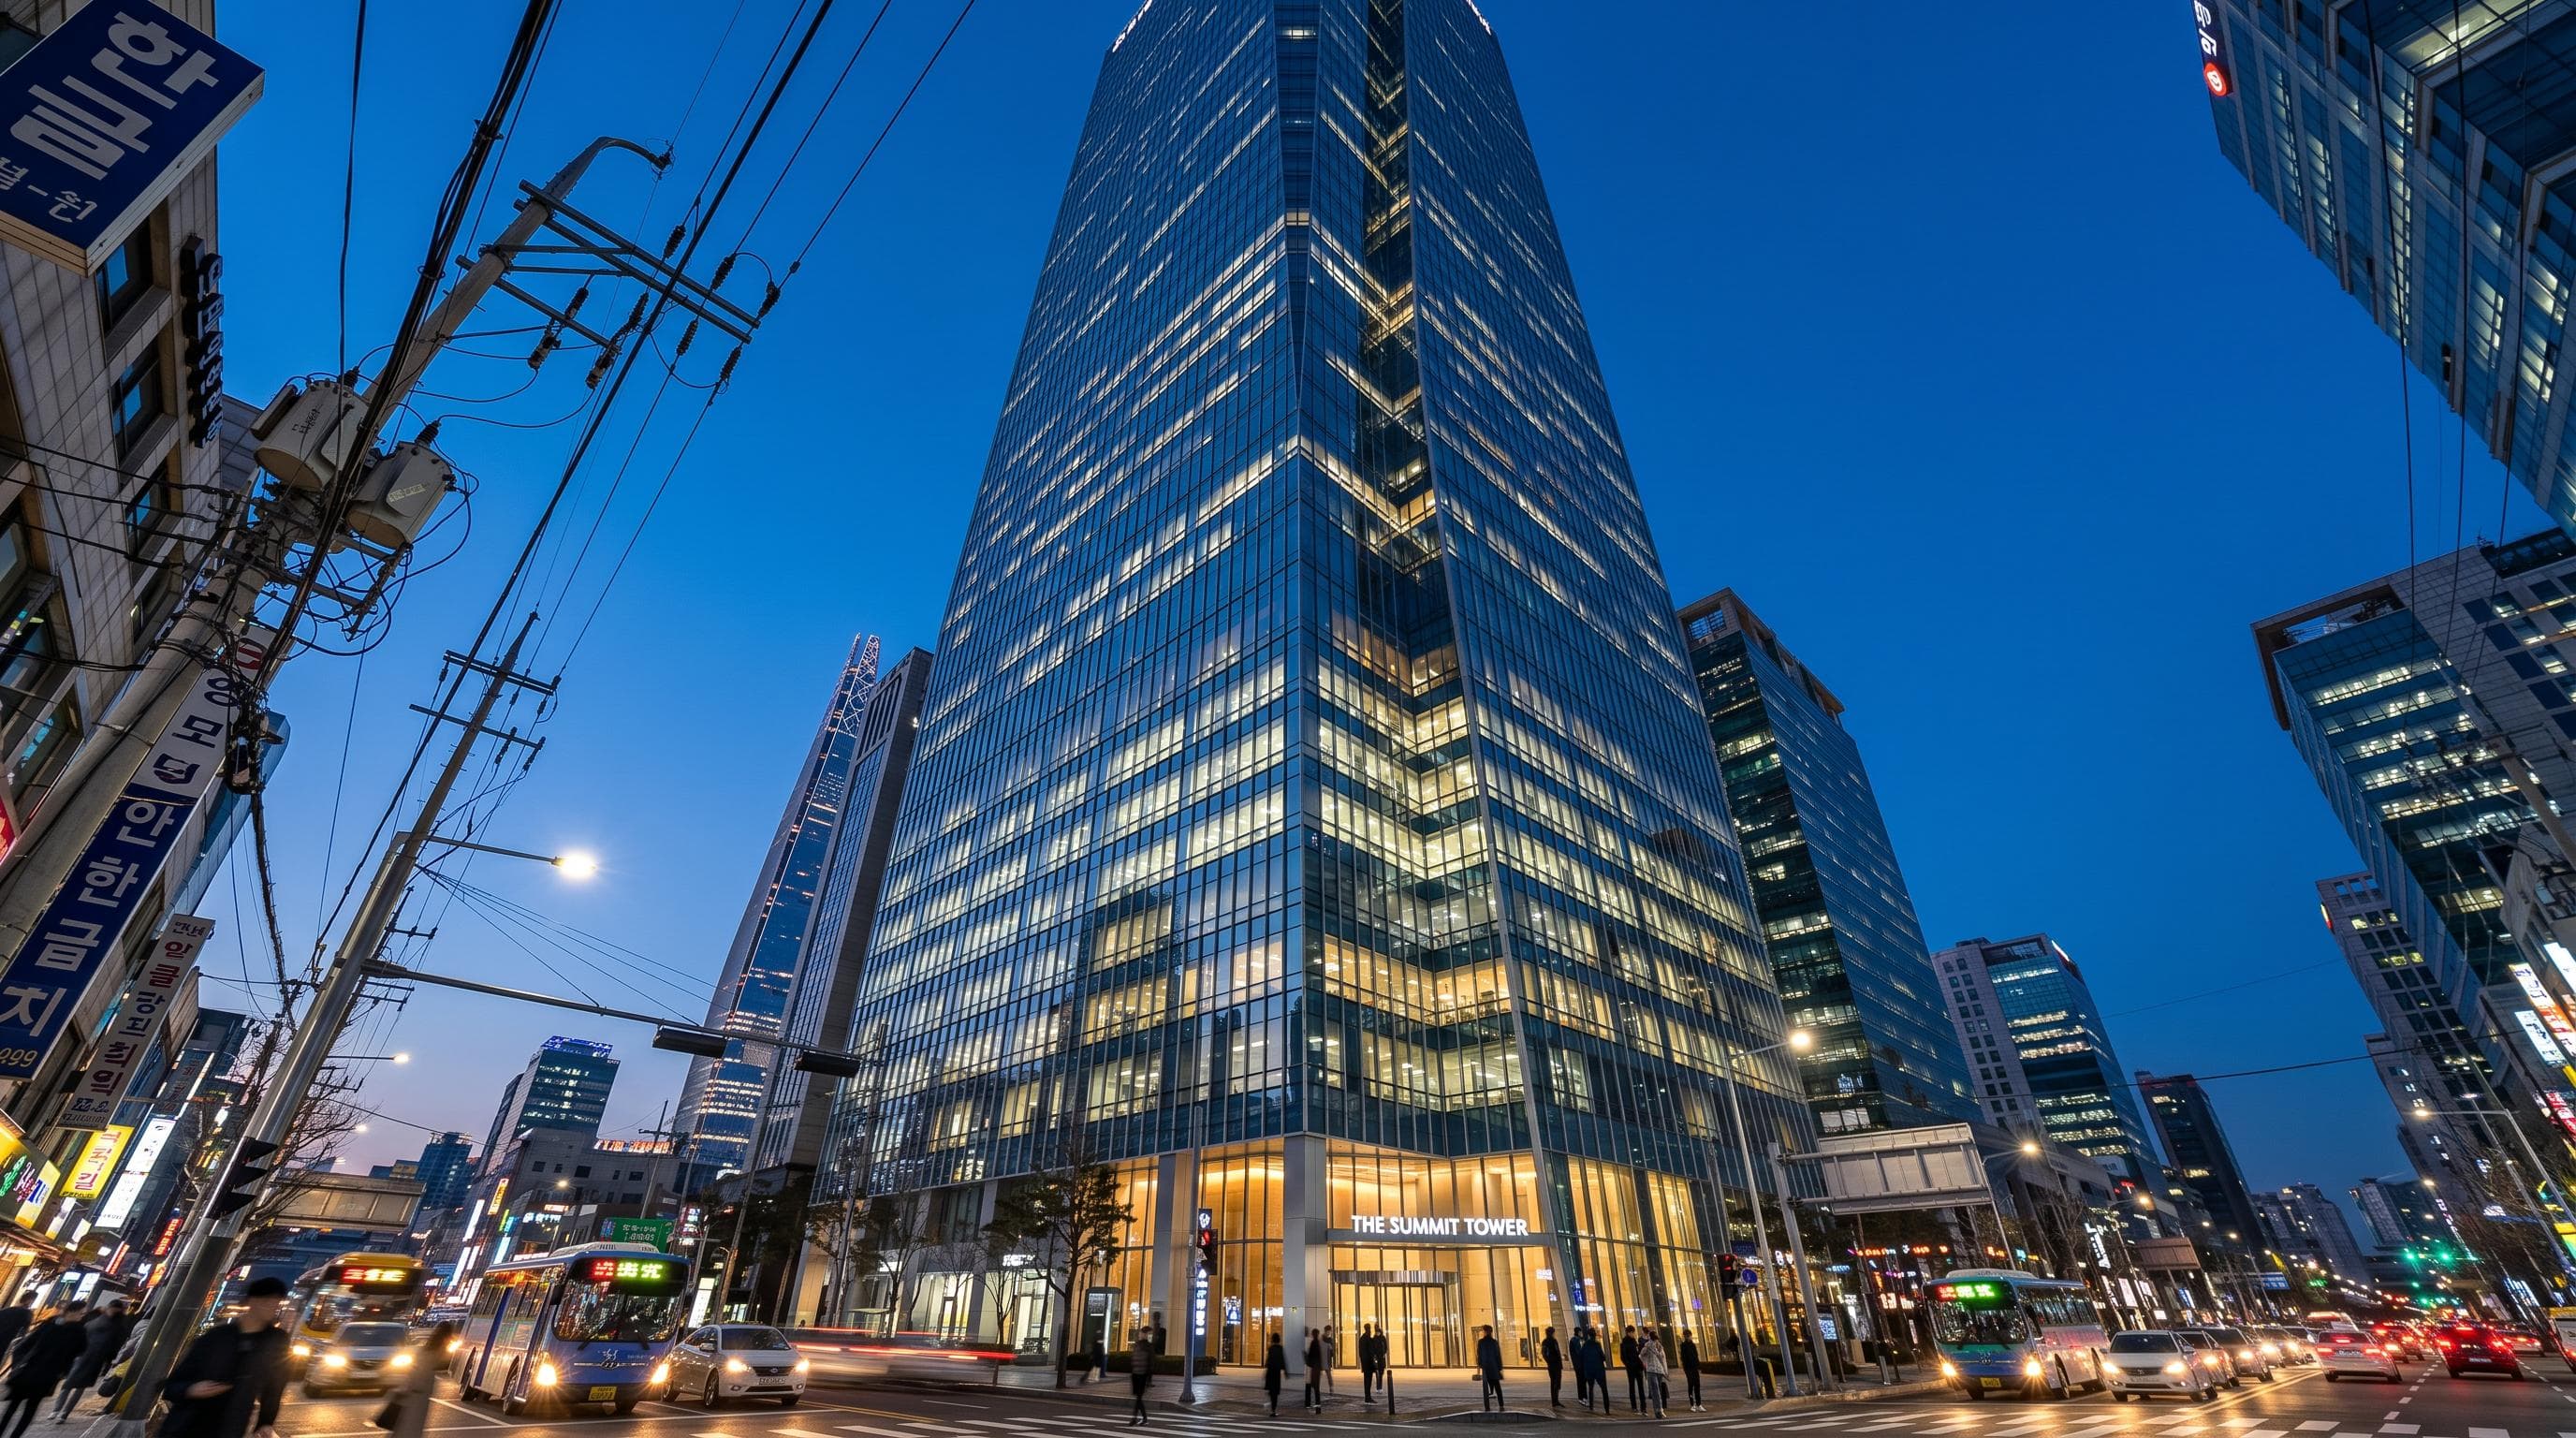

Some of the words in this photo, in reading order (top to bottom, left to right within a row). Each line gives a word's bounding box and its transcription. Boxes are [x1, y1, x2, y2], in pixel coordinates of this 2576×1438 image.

[1351, 1214, 1385, 1233] THE
[1390, 1217, 1459, 1235] SUMMIT
[1464, 1218, 1529, 1236] TOWER
